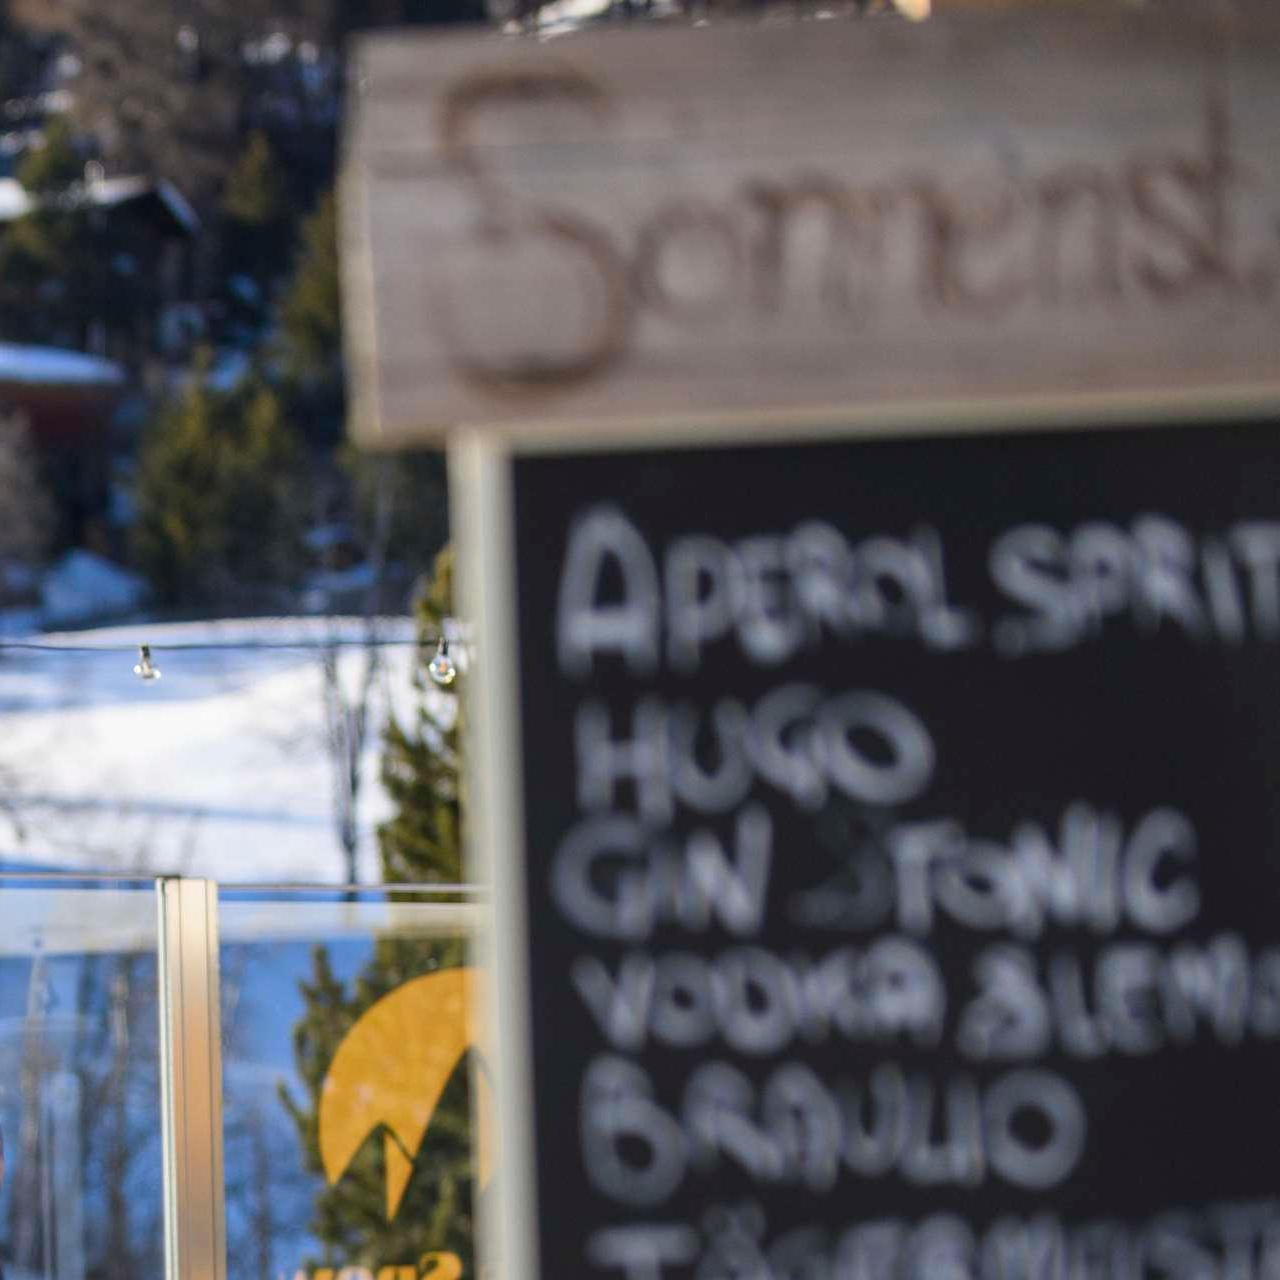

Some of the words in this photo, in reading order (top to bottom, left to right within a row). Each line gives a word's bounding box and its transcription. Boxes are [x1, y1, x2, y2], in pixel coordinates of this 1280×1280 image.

[557, 505, 973, 675] APEROL
[571, 685, 936, 815] HUGO
[553, 808, 774, 938] GIN
[886, 803, 1199, 938] TONIC
[569, 938, 944, 1056] VODKA
[579, 1058, 1089, 1204] BRAULIO
